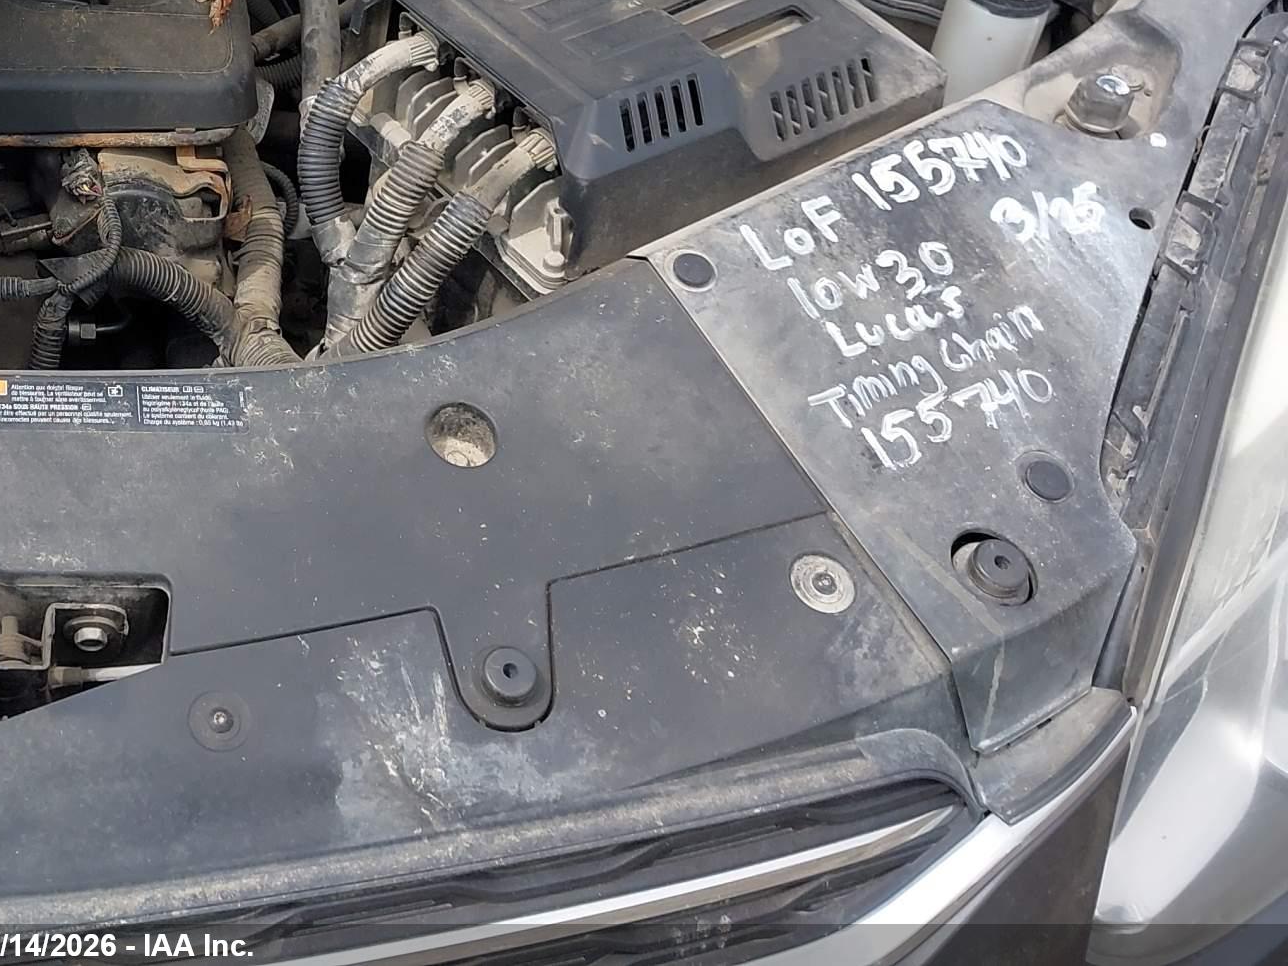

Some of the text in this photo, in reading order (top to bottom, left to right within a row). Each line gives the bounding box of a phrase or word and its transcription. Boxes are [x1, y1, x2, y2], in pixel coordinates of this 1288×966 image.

[852, 132, 1028, 210] 155740
[825, 286, 965, 357] Lucas
[808, 354, 947, 428] Timing
[861, 369, 1054, 469] 155740
